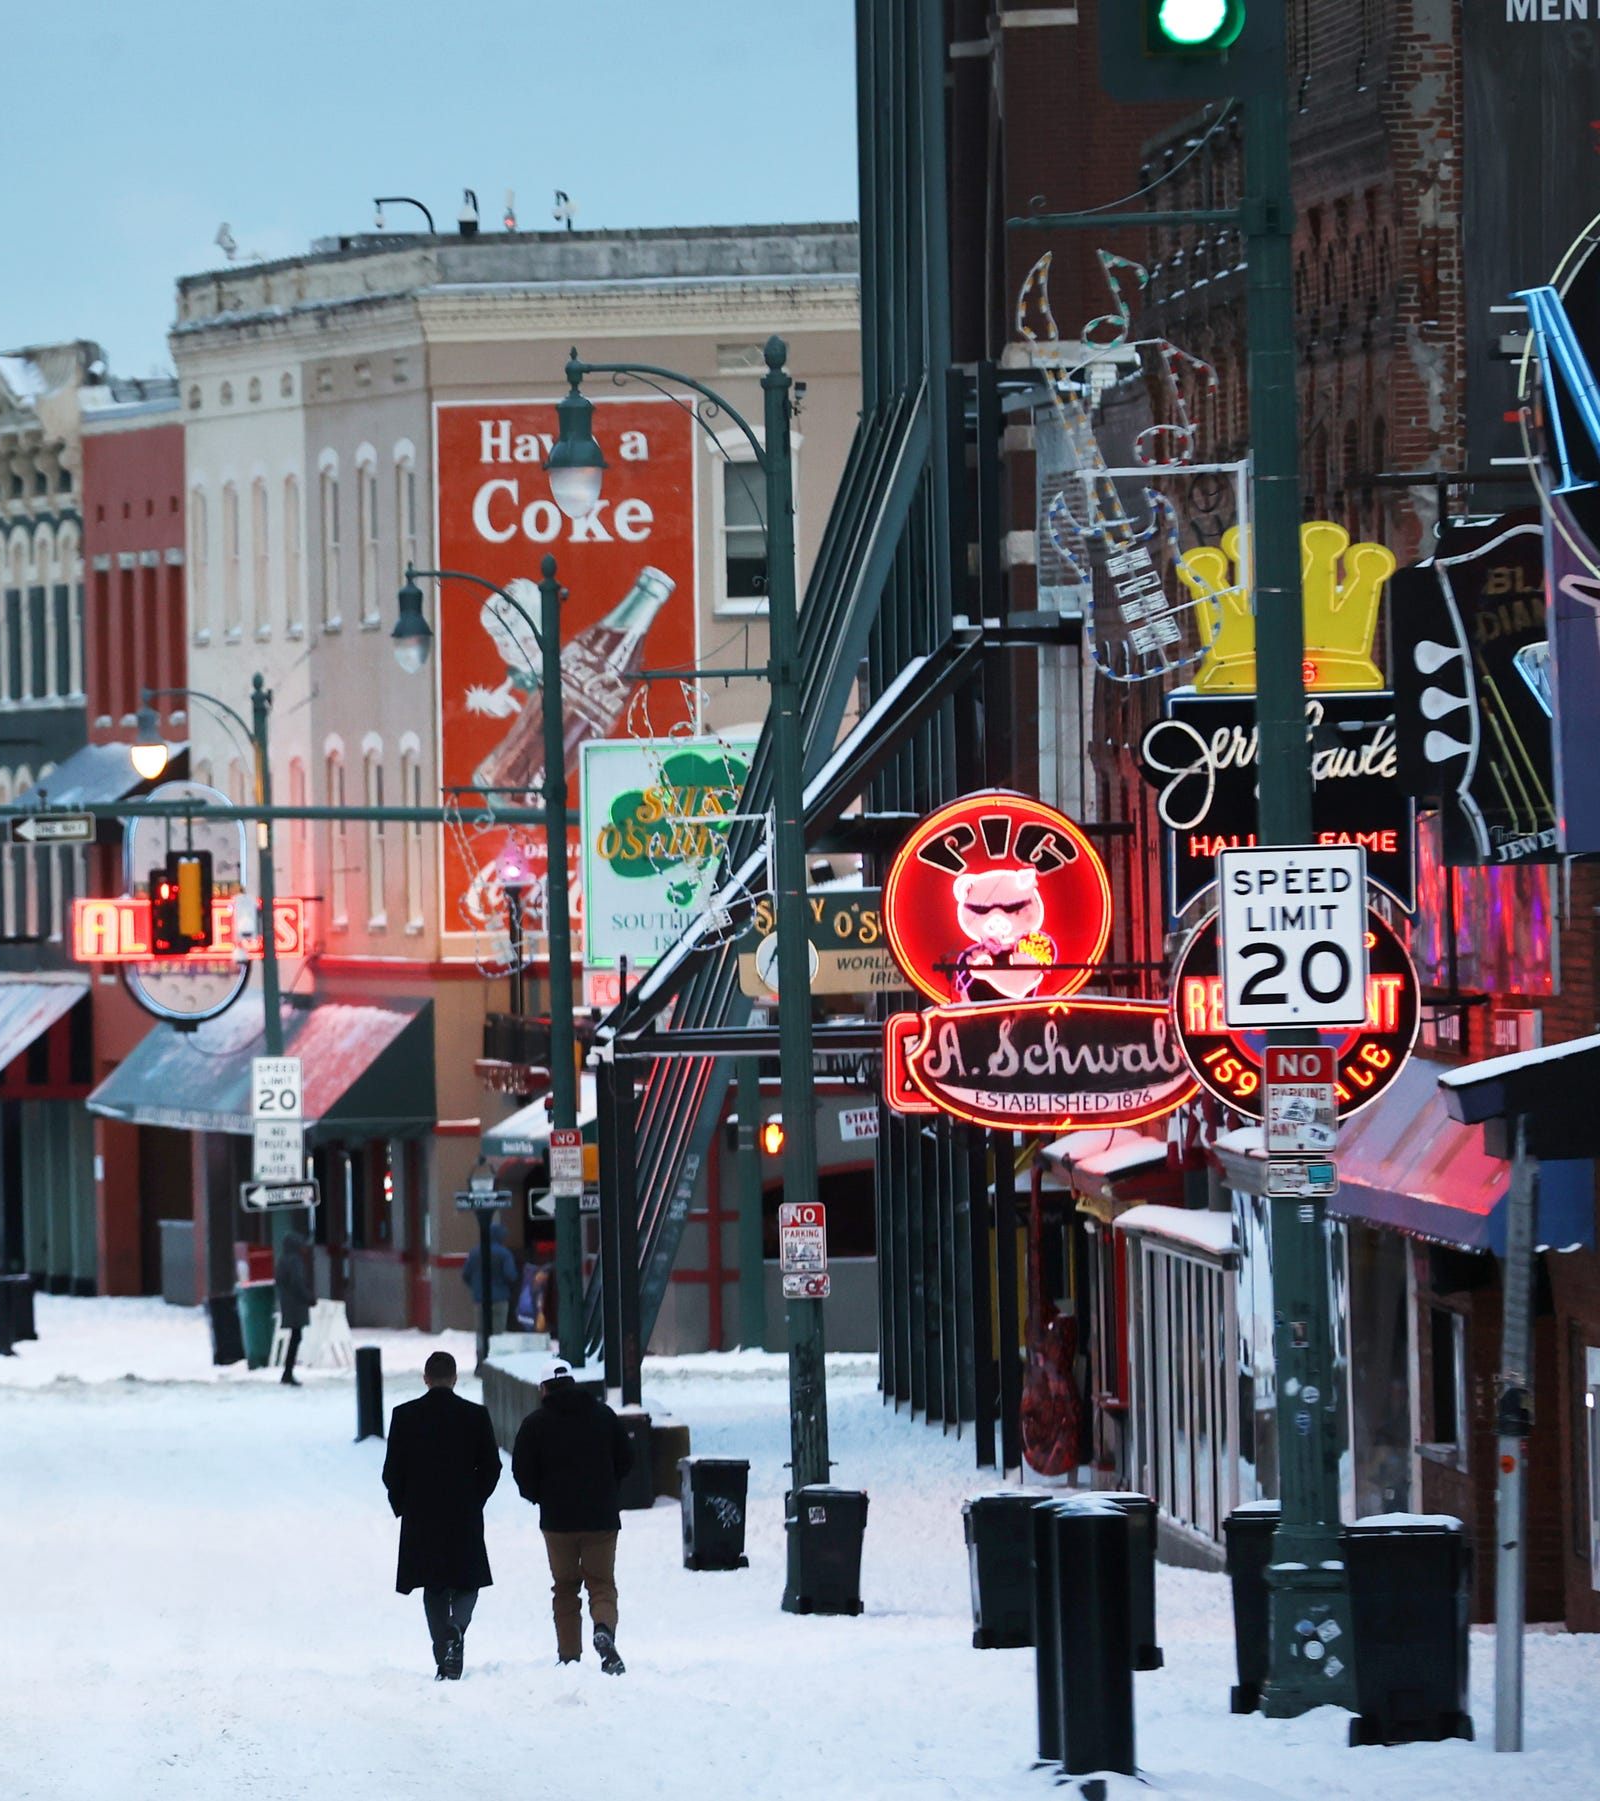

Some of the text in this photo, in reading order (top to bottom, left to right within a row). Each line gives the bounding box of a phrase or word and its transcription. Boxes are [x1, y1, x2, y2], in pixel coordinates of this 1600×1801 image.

[620, 431, 649, 462] a
[472, 479, 654, 543] Coke
[917, 815, 1079, 875] PIG
[1233, 867, 1352, 896] SPEED
[1247, 905, 1339, 931] LIMIT
[1238, 941, 1351, 1006] 20
[923, 1020, 980, 1078] A.
[987, 1017, 1186, 1078] Schwab
[1203, 1047, 1259, 1097] 159
[1277, 1054, 1322, 1077] NO
[259, 1089, 297, 1110] 20
[975, 1091, 1154, 1113] ESTABLISHED 1876
[1271, 1087, 1327, 1100] PARKING
[554, 1135, 575, 1145] NO
[788, 1207, 816, 1224] NO
[784, 1229, 820, 1239] PARKING
